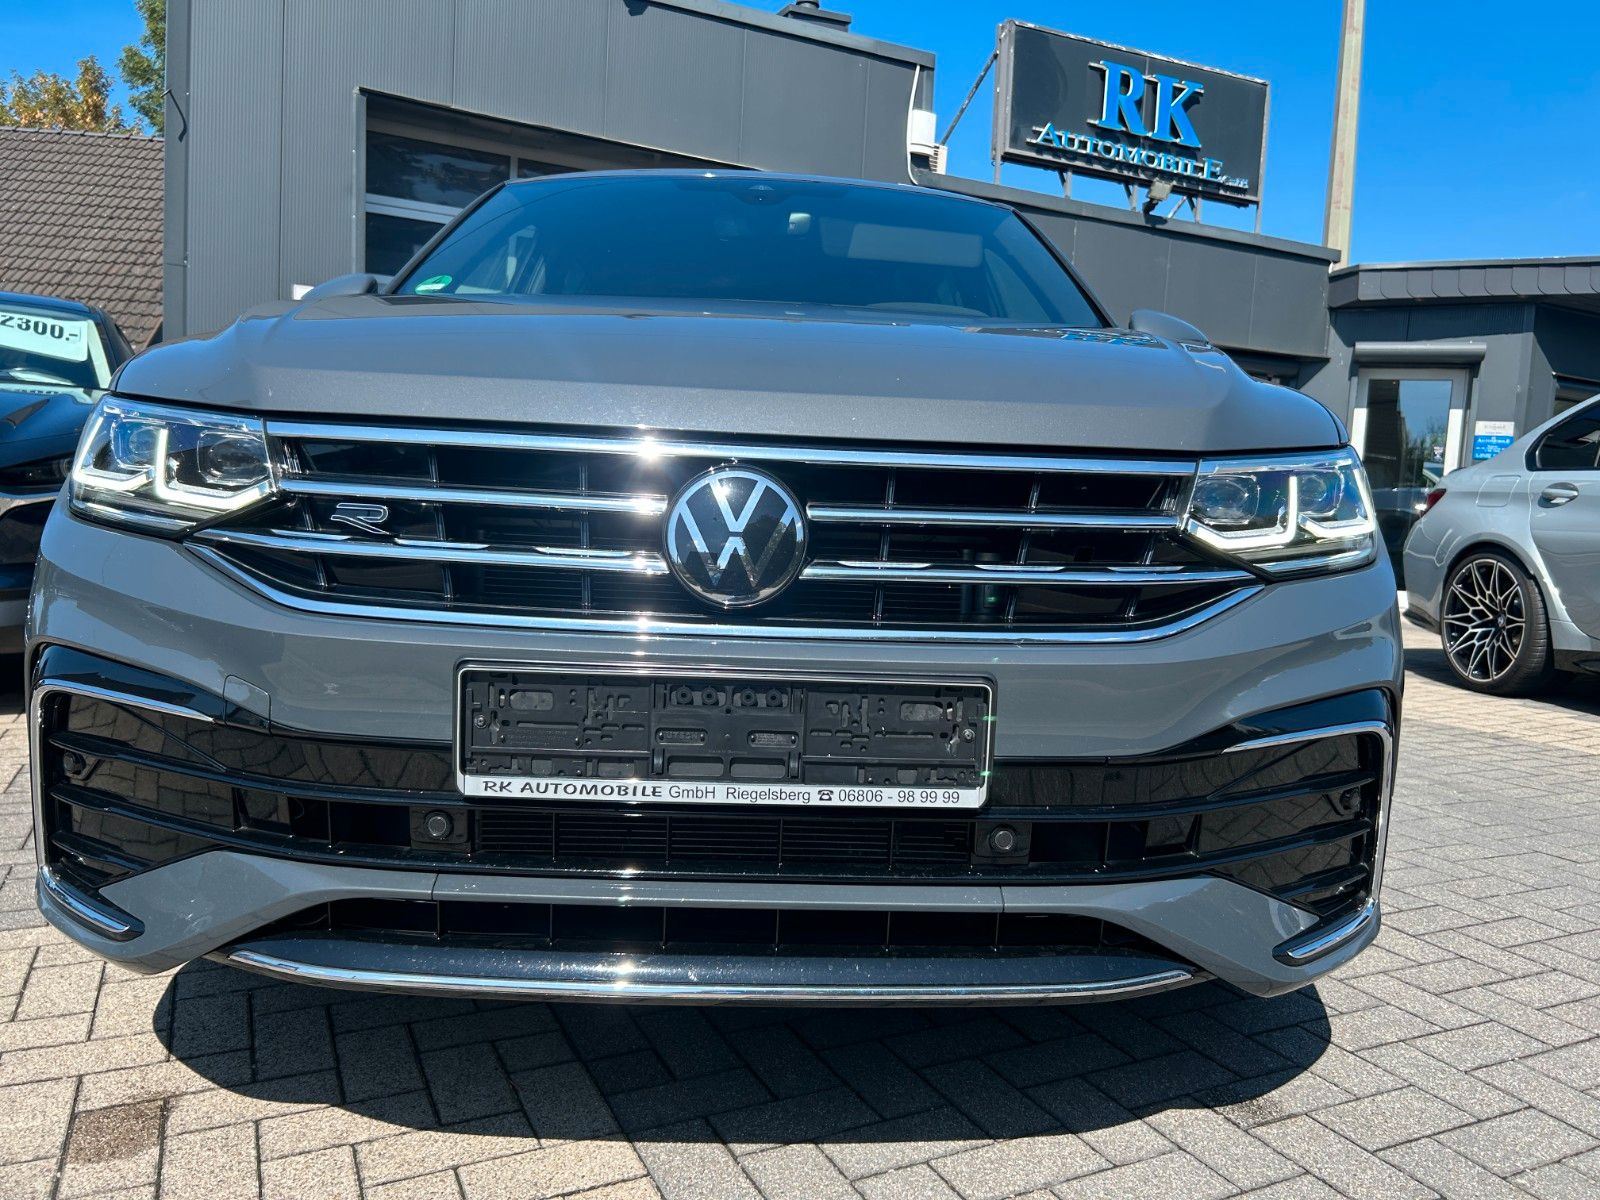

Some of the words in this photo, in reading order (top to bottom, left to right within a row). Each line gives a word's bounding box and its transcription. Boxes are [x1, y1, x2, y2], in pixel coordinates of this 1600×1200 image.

[1087, 60, 1205, 149] RK
[482, 780, 513, 793] RK
[520, 781, 662, 798] AUTOMOBILE
[668, 785, 716, 799] GmbH
[726, 786, 811, 804] Riegelsberg
[838, 788, 883, 803] 06806
[897, 789, 915, 803] 98
[920, 790, 938, 804] 99
[942, 790, 960, 804] 99
